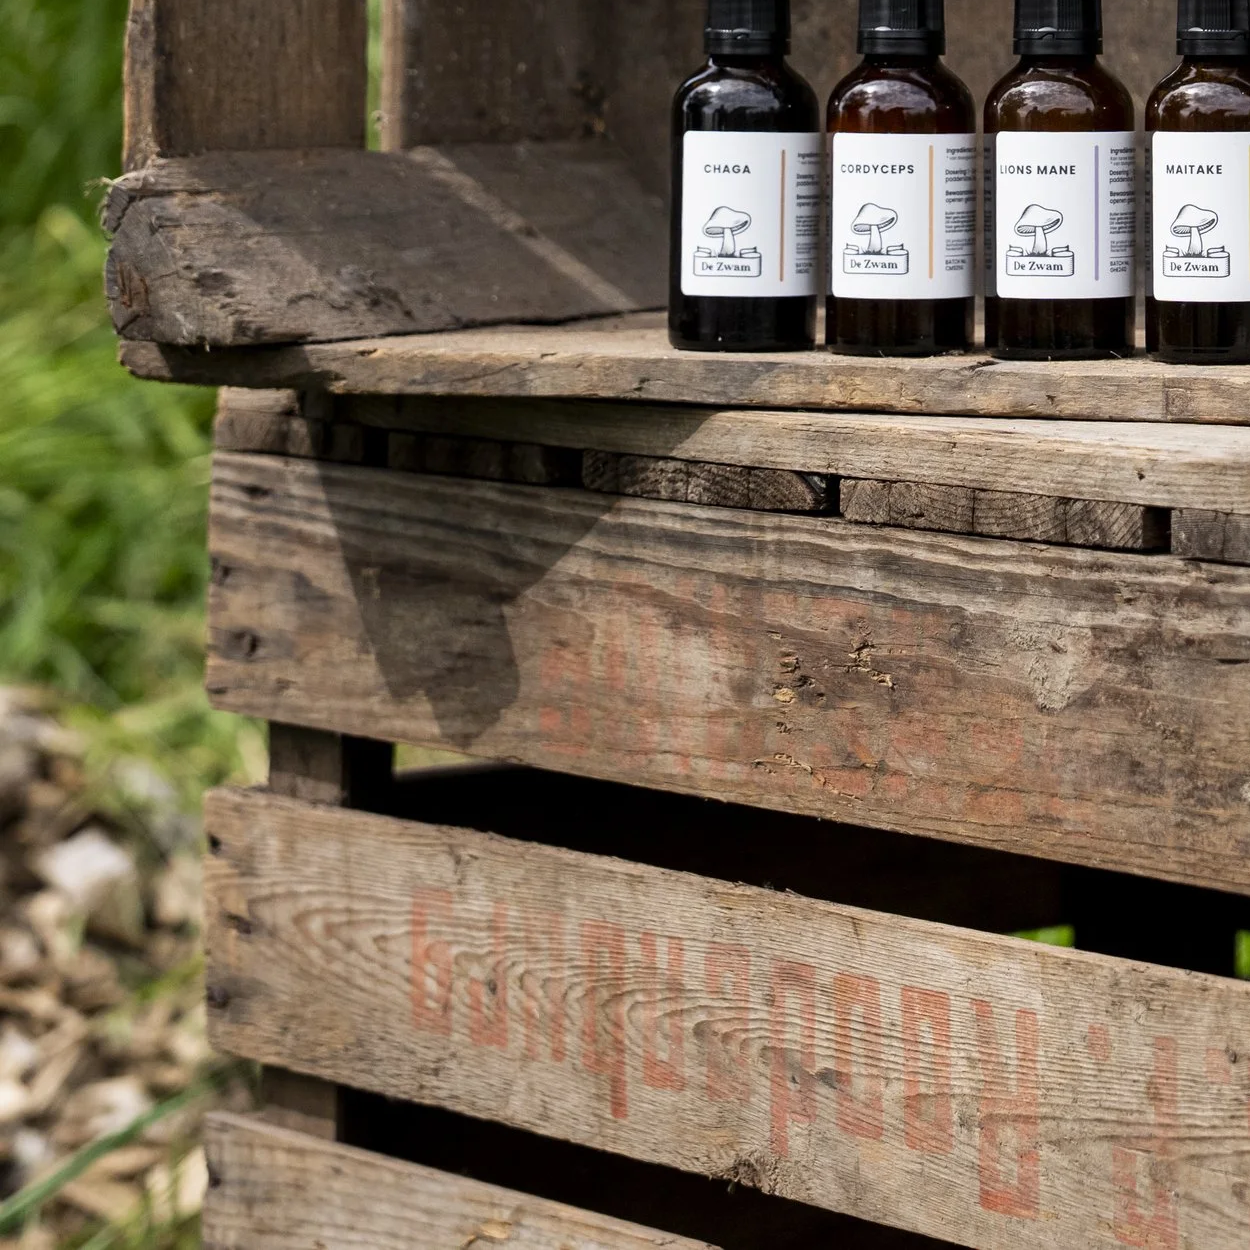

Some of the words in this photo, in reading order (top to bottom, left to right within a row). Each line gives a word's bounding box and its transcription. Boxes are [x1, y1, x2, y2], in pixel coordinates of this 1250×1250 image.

[704, 164, 751, 174] CHAGA
[841, 164, 914, 174] CORDYCEPS
[1000, 165, 1032, 175] LIONS
[1037, 165, 1076, 175] MANE
[1166, 165, 1222, 174] MAITAKE
[702, 262, 713, 271] De
[716, 261, 751, 271] Zwam
[851, 259, 861, 269] De
[864, 259, 898, 269] Zwam
[1014, 261, 1025, 270] De
[1028, 261, 1063, 271] Zwam
[1171, 262, 1182, 271] De
[1185, 262, 1219, 272] Zwam
